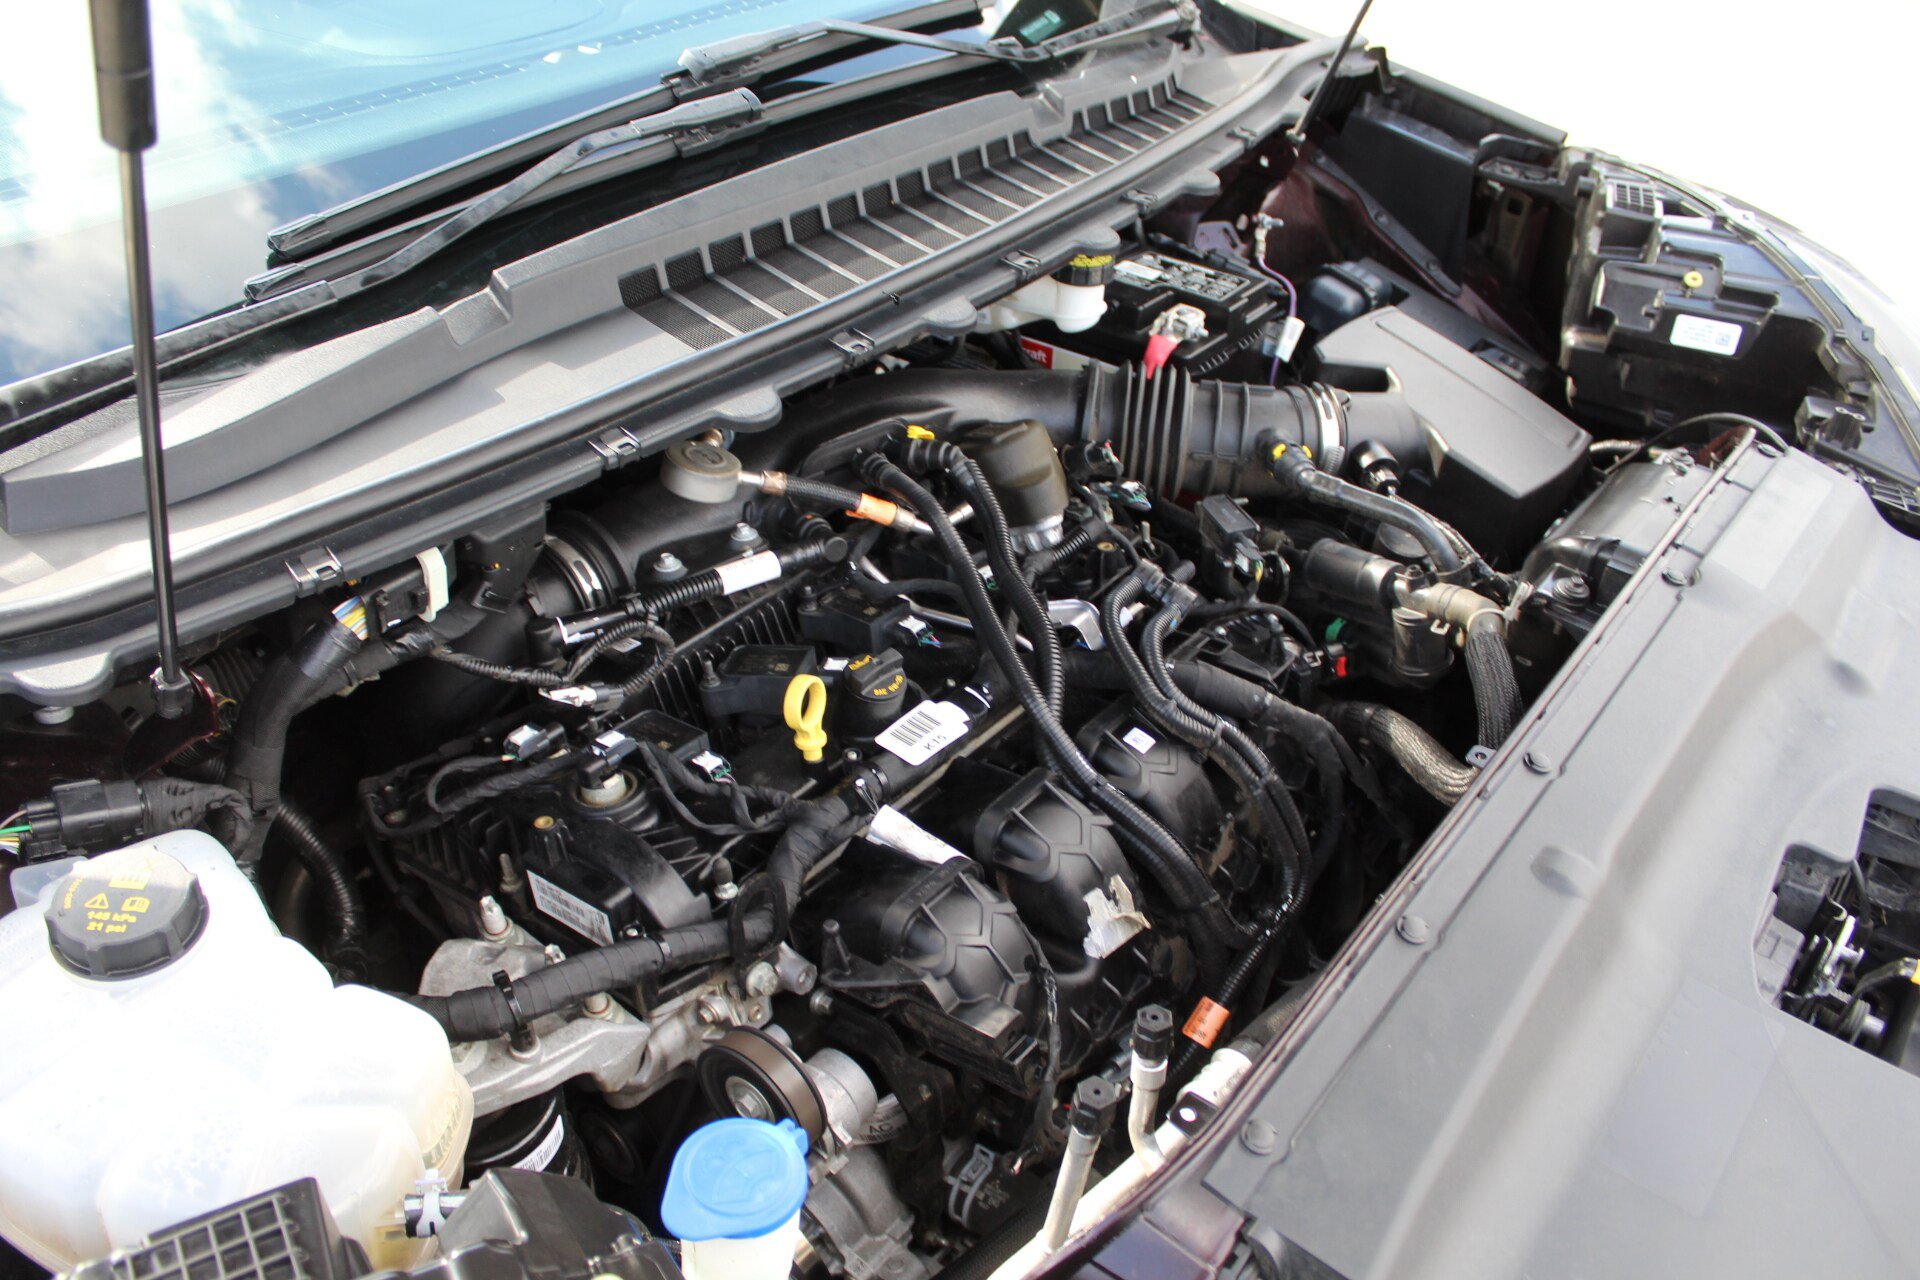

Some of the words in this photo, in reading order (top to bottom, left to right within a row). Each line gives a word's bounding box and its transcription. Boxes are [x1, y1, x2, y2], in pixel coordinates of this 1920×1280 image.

[87, 910, 111, 921] 145
[112, 912, 137, 923] kPa
[86, 921, 104, 931] 21
[105, 923, 127, 934] psi
